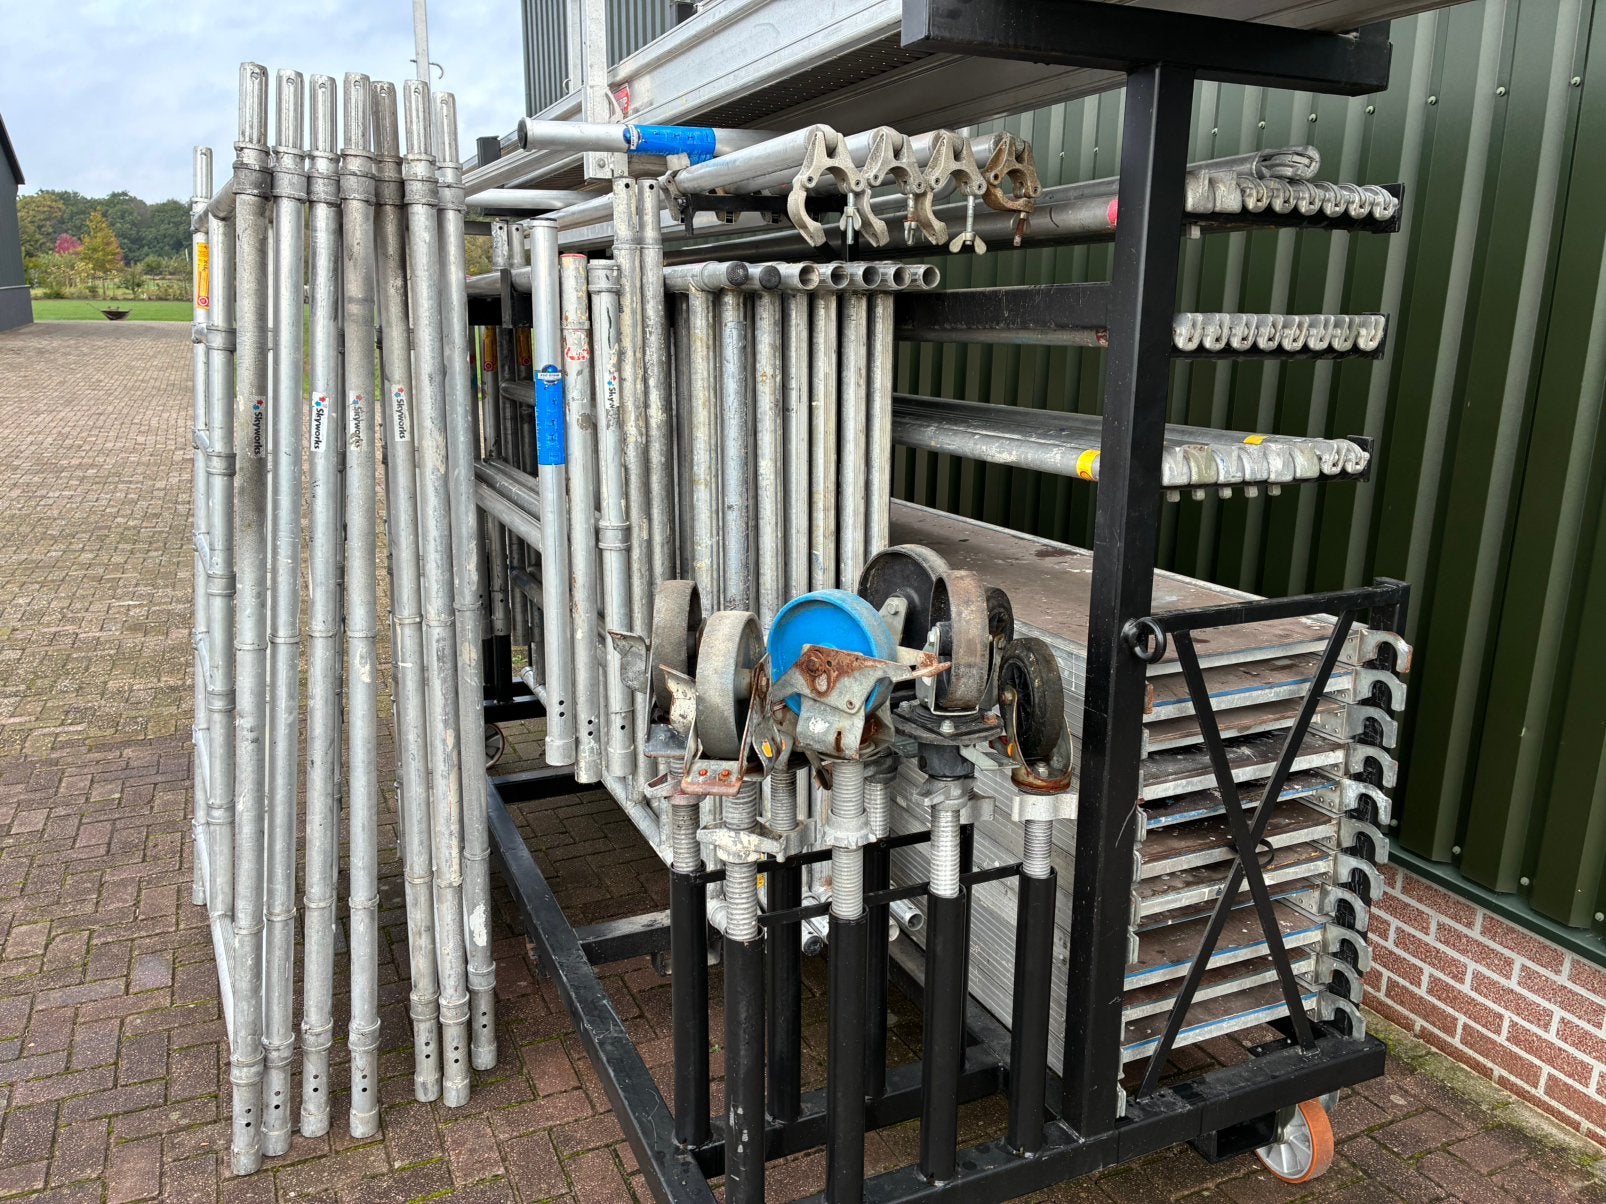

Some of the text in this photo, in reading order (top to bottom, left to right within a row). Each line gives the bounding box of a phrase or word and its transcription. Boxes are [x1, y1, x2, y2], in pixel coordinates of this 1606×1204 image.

[252, 411, 263, 455] Skyworks
[314, 408, 324, 450] Skyworks
[353, 407, 363, 448] Skyworks
[396, 399, 406, 439] Skyworks
